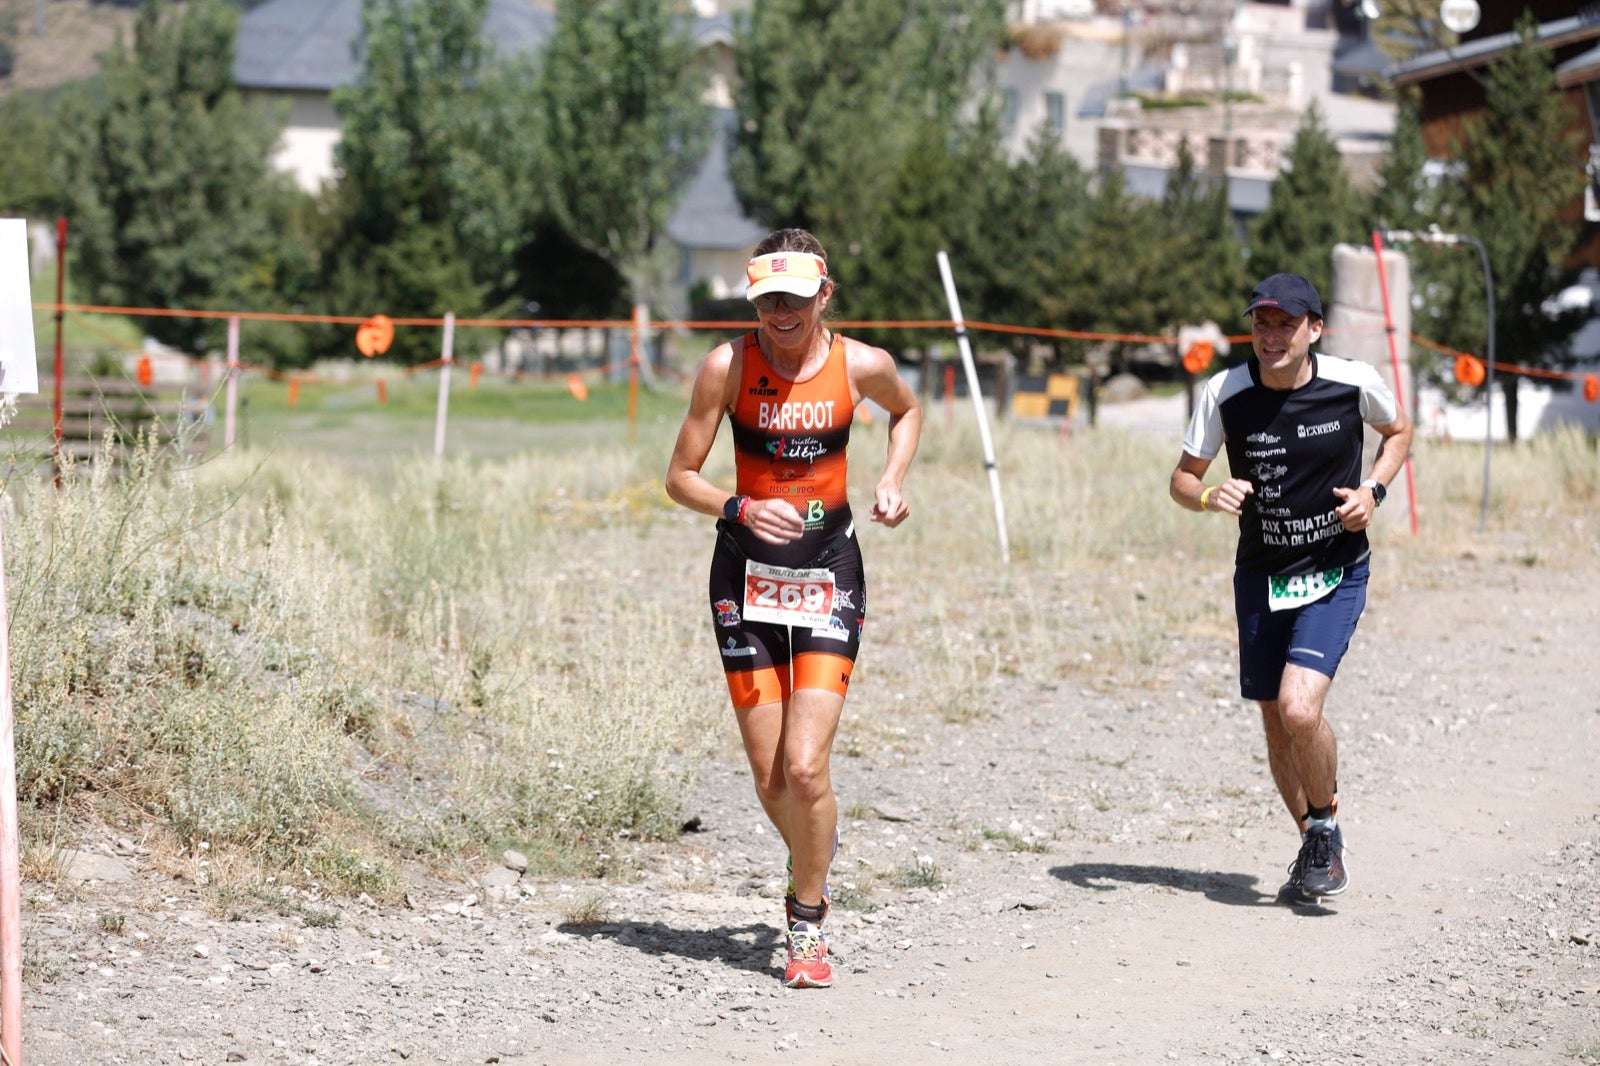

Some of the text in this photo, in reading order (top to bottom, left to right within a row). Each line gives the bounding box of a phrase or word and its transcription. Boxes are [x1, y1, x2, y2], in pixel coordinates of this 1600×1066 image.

[749, 387, 778, 396] VIATOR
[758, 400, 835, 429] BARFOOT
[1252, 447, 1287, 458] segurma
[1261, 519, 1280, 533] XIX
[1263, 532, 1289, 546] VILLA
[1291, 535, 1304, 546] DE
[755, 580, 825, 612] 269
